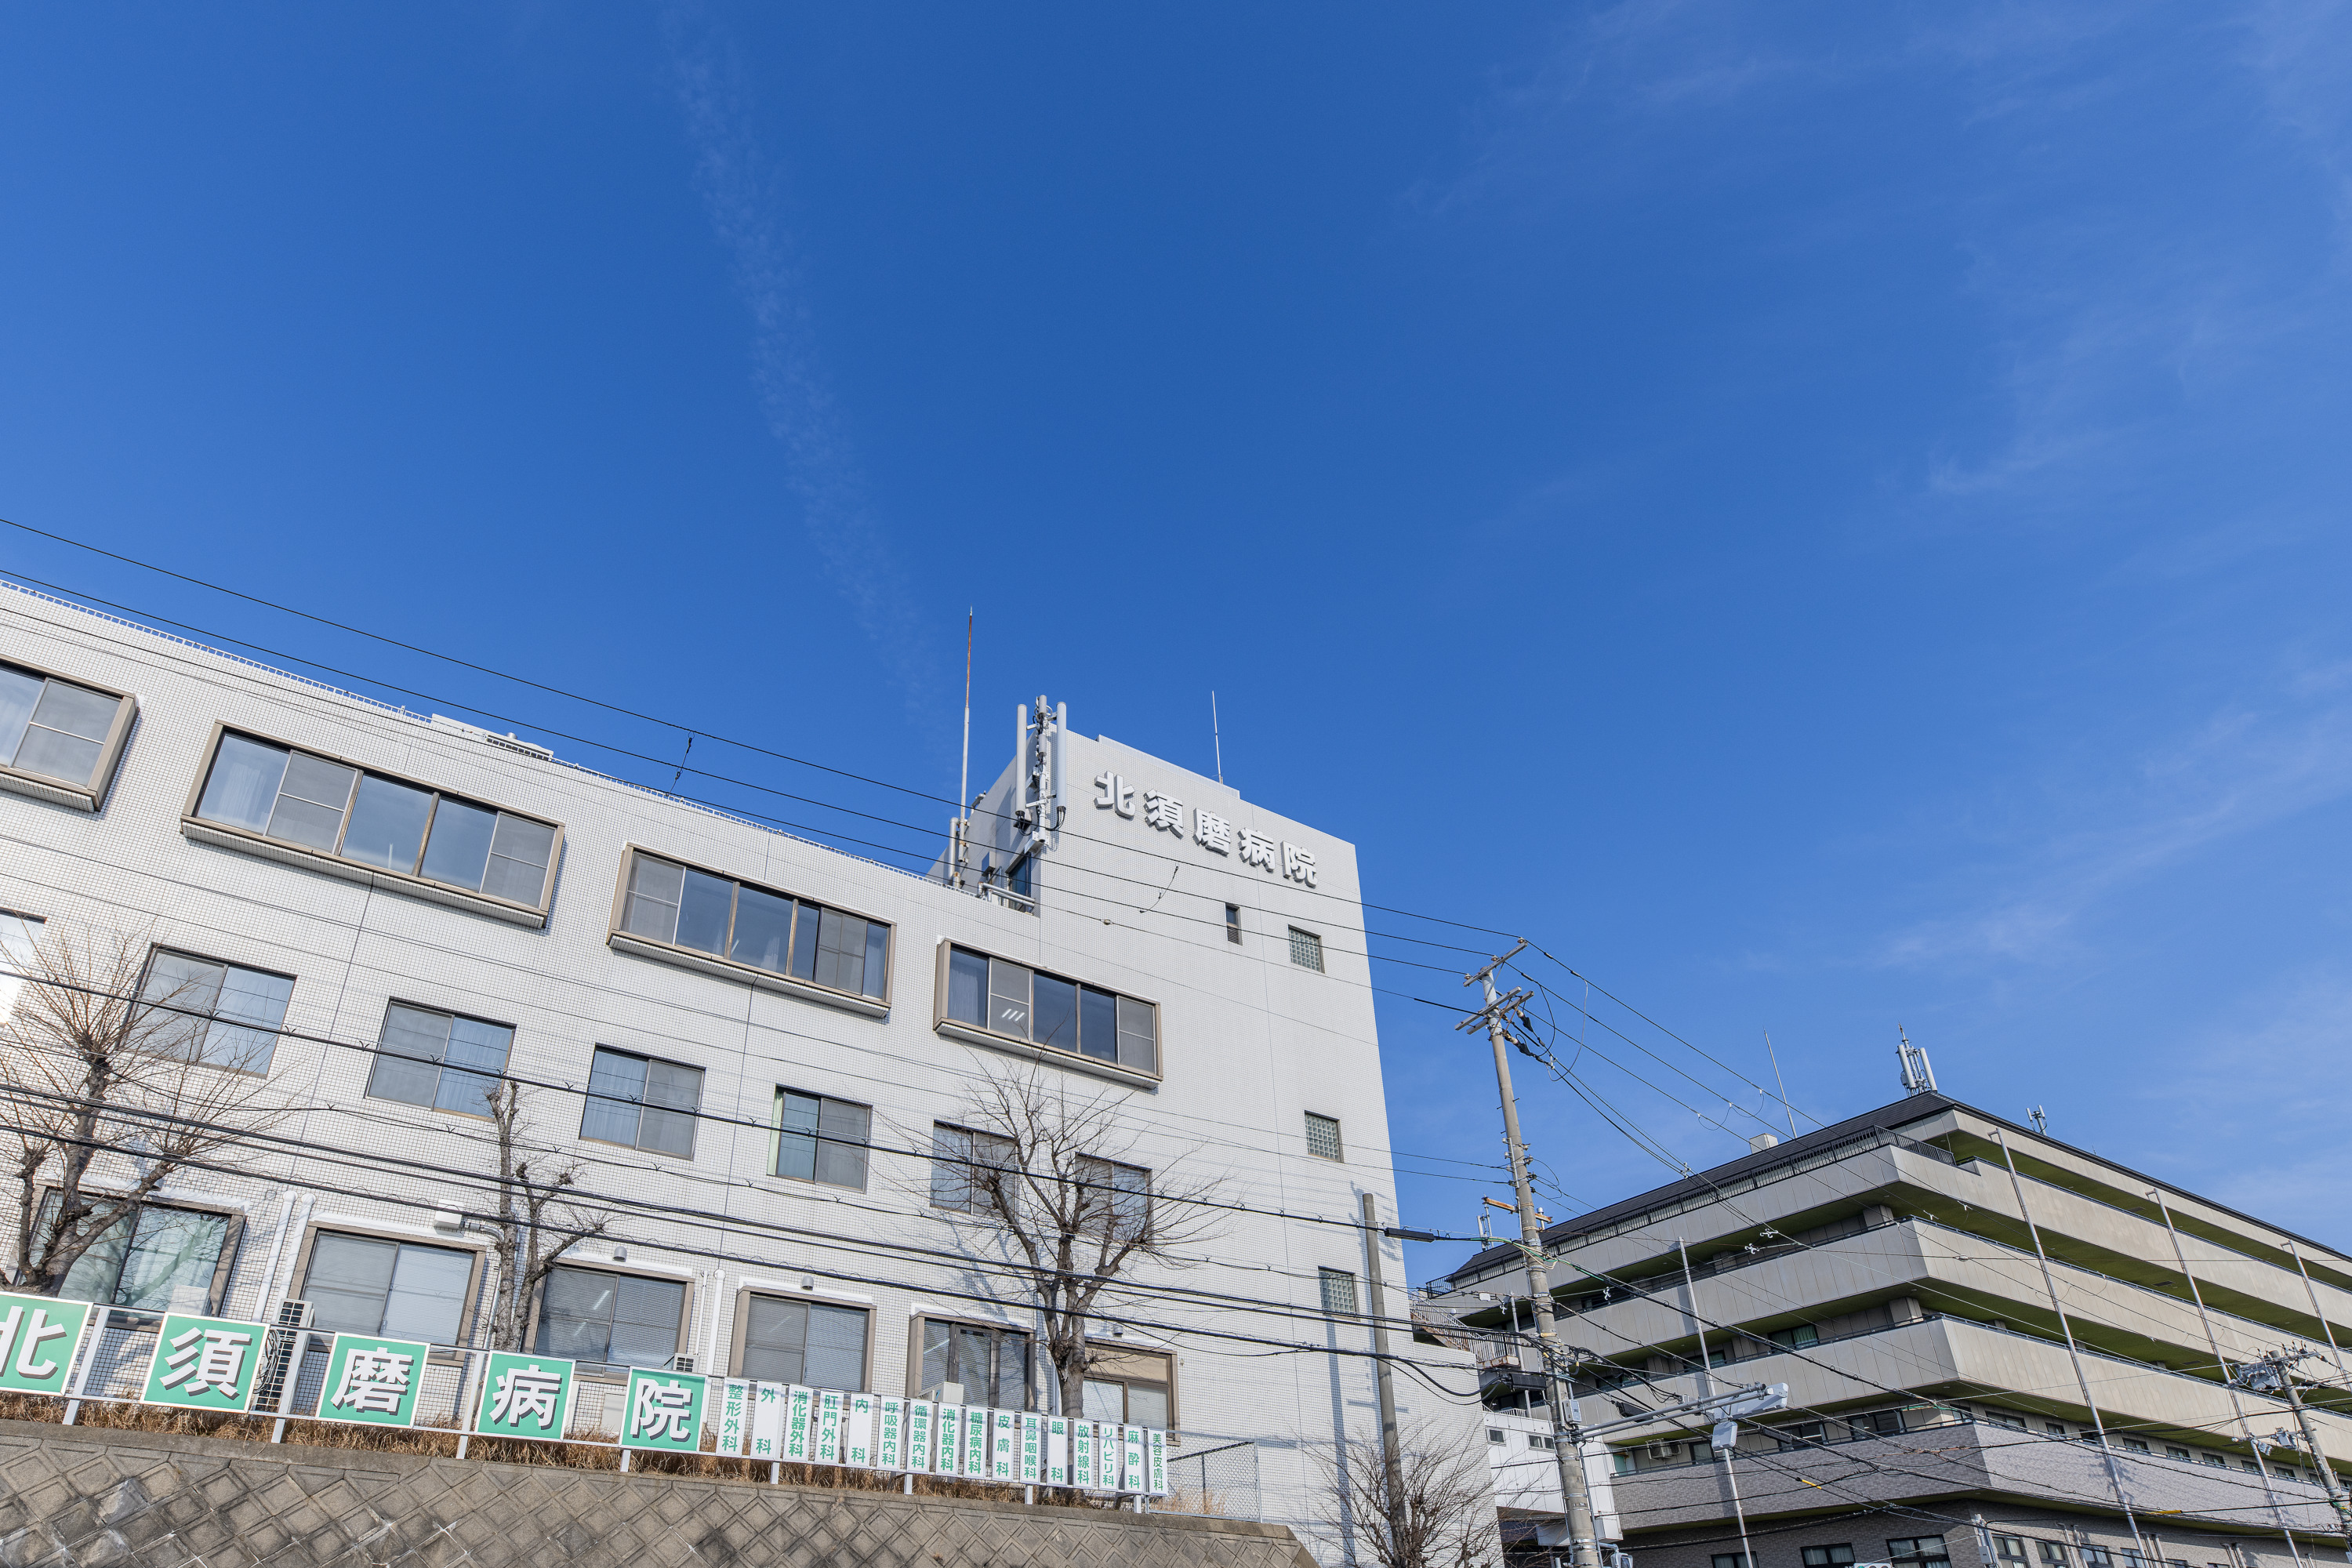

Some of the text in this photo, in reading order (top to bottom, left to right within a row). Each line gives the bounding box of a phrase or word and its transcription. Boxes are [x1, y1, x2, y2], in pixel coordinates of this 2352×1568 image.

[1094, 771, 1319, 887] 北須磨病院
[722, 1385, 743, 1451] 整形外科
[757, 1388, 775, 1454] 外科
[789, 1391, 808, 1457] 消化器外科
[820, 1395, 838, 1460] 肛門外科
[851, 1399, 868, 1462] 内科
[882, 1403, 898, 1465] 呼吸器内科
[912, 1405, 927, 1468] 循環器内科
[941, 1409, 955, 1471] 消化器内科
[969, 1412, 982, 1474] 糖尿病内科
[996, 1415, 1010, 1476] 皮膚科
[1025, 1417, 1037, 1479] 耳鼻咽喉科
[1051, 1421, 1063, 1482] 眼科
[1078, 1425, 1089, 1484] 放射線科
[1103, 1428, 1114, 1486] リハビリ科
[1128, 1431, 1140, 1489] 麻酔科
[1153, 1434, 1163, 1490] 美容皮膚科
